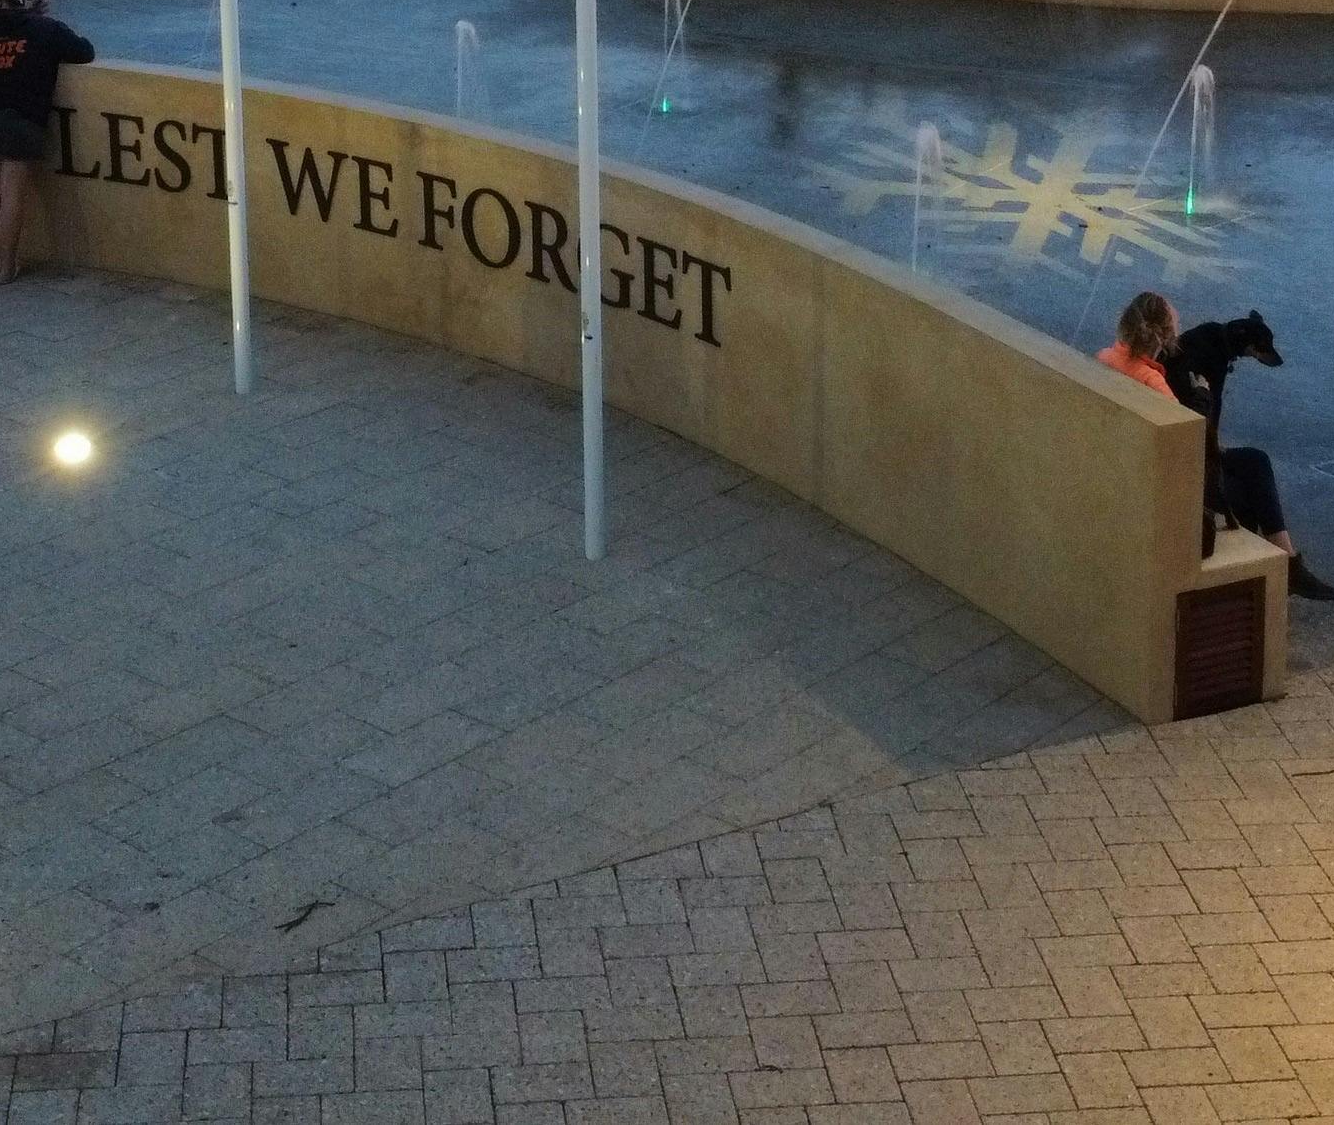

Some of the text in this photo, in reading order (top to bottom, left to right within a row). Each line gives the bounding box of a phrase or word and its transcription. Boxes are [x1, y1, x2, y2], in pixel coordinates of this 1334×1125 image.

[54, 106, 732, 349] LEST WE FORGET
